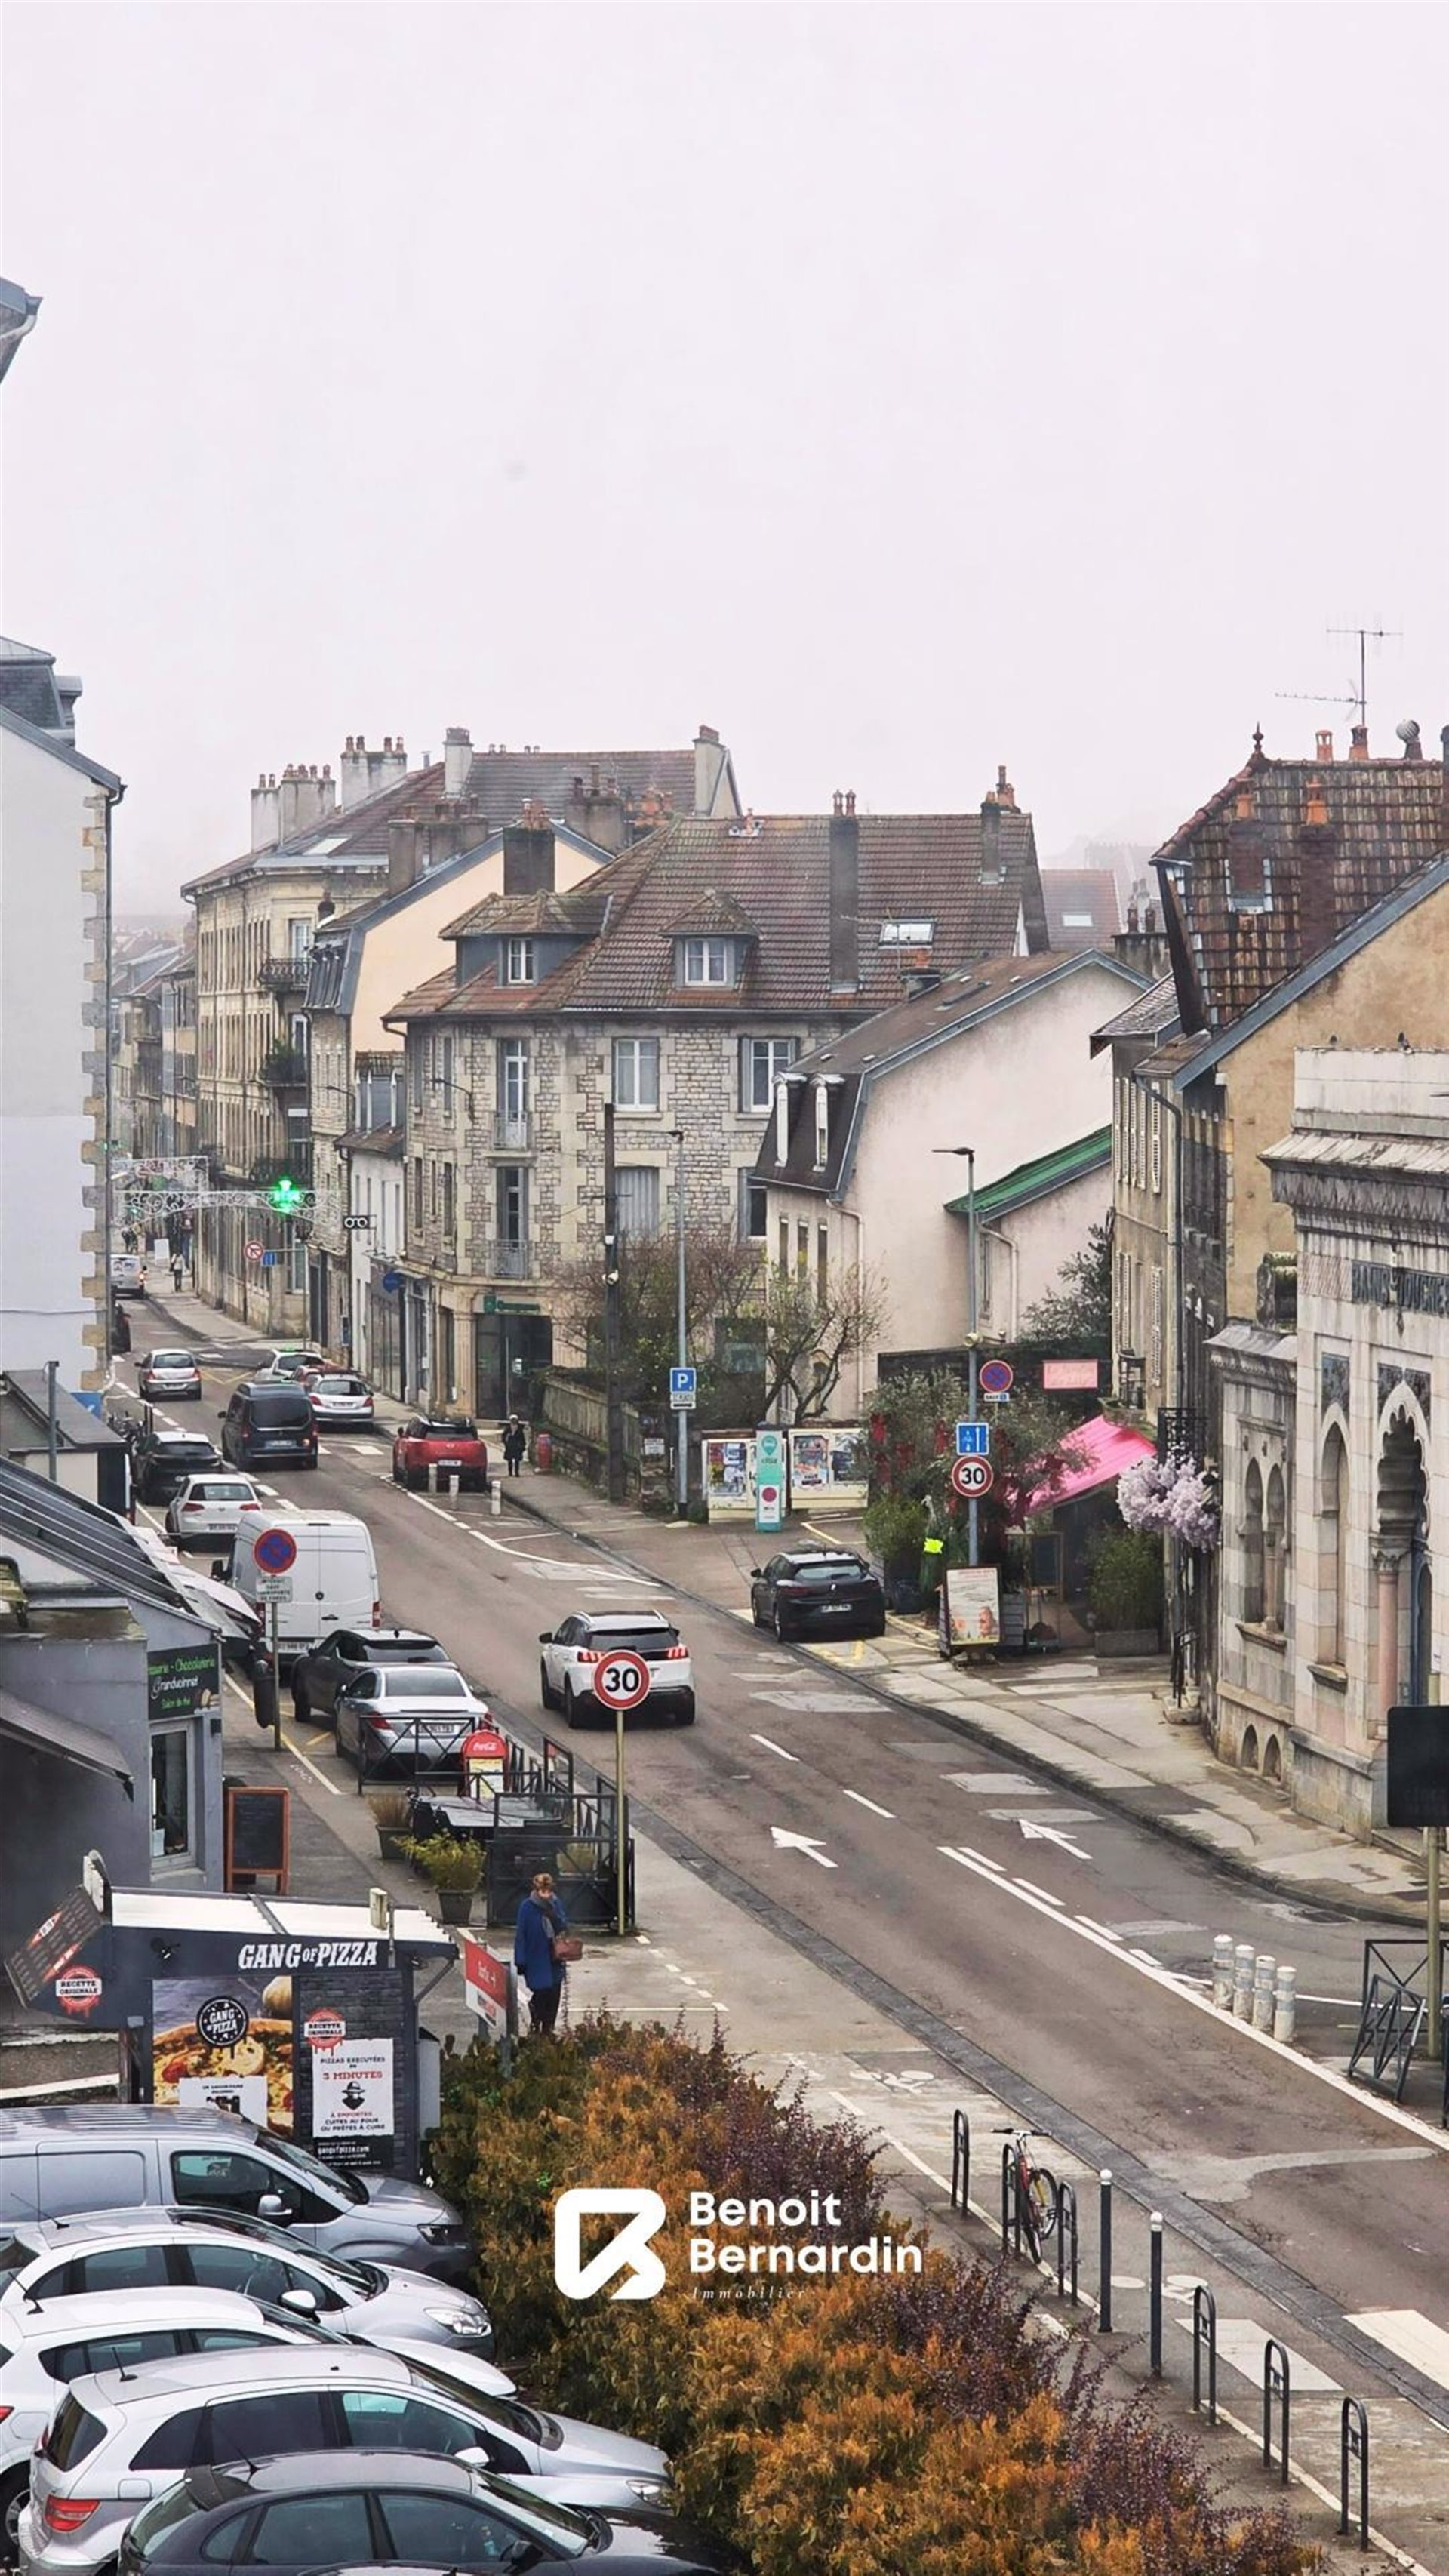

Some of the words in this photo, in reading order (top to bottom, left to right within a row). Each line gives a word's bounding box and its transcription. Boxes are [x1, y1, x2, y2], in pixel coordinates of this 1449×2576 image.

[678, 1373, 688, 1389] P
[961, 1467, 985, 1485] 30
[605, 1667, 640, 1692] 30
[238, 1943, 302, 1969] GANG
[315, 1940, 378, 1968] PIZZA
[209, 2008, 235, 2024] GANG
[212, 2019, 238, 2034] PIZZA
[333, 2070, 383, 2080] MINUTES
